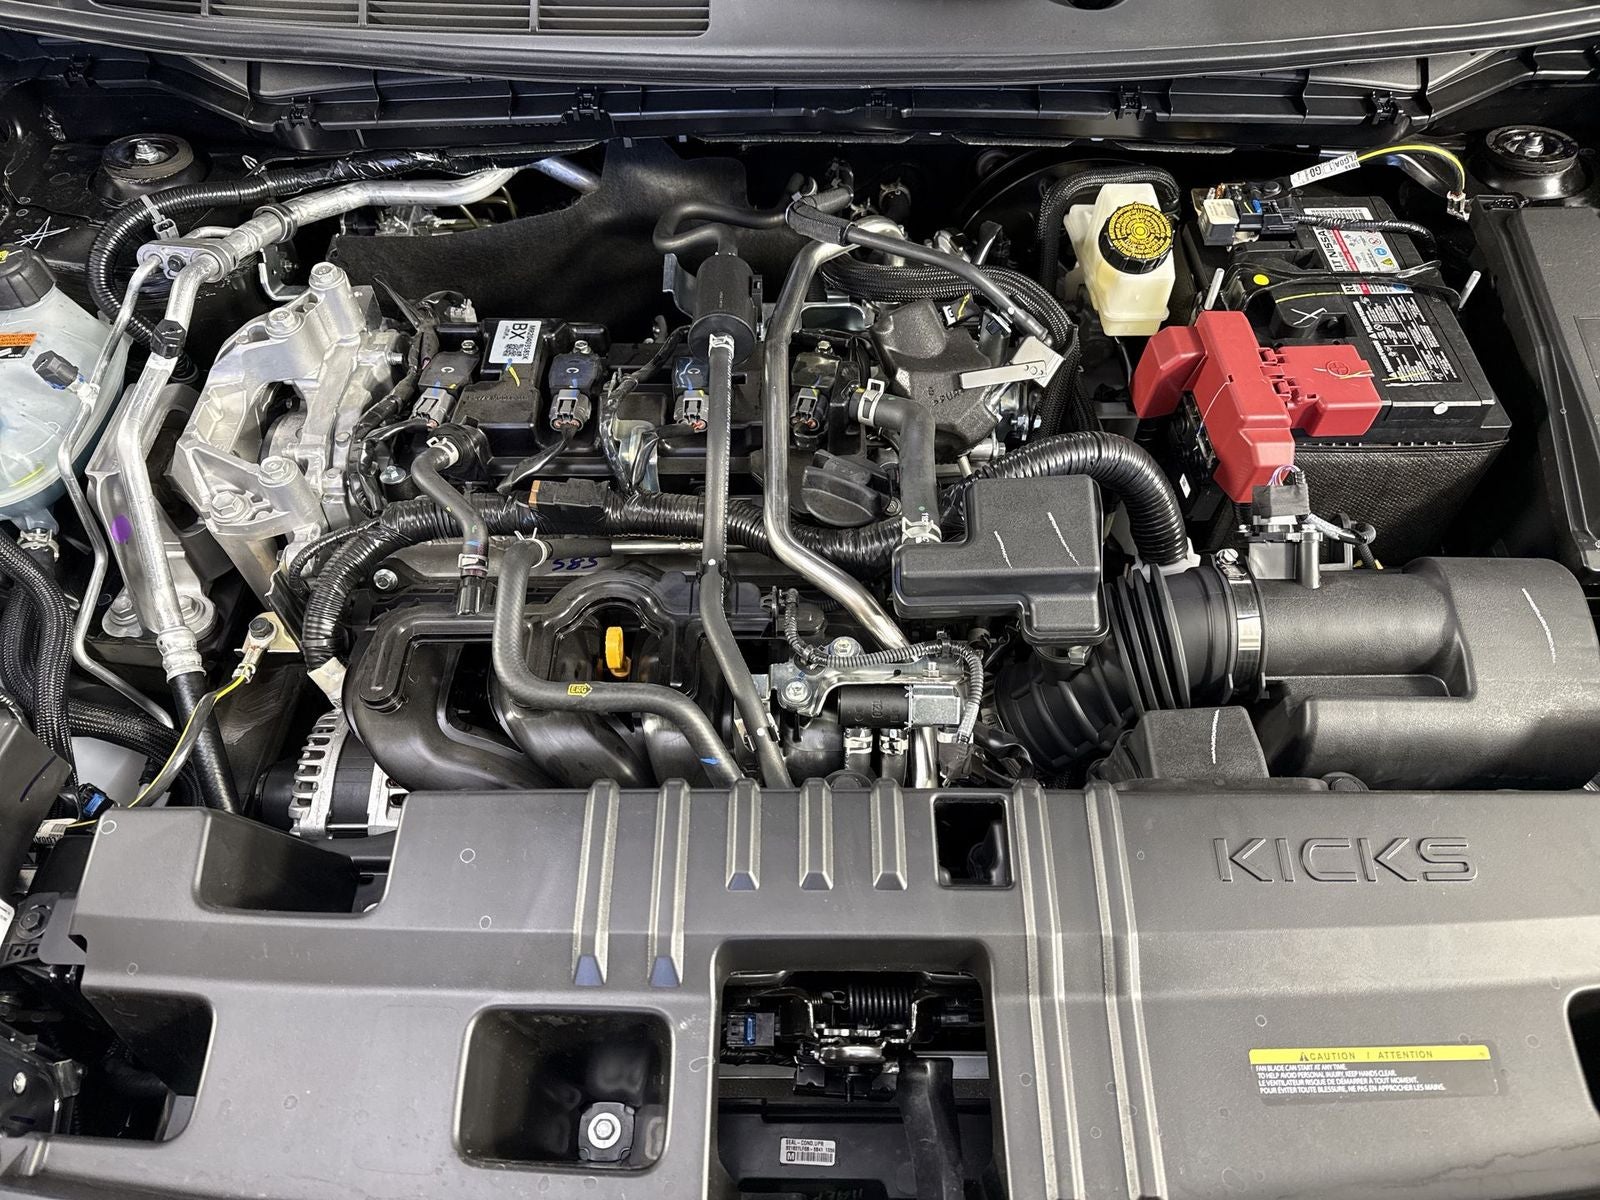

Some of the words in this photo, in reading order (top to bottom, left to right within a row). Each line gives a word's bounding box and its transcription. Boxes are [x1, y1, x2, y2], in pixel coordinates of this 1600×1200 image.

[1316, 227, 1338, 258] NISSA
[509, 324, 528, 339] BX
[1214, 837, 1478, 882] KICKS
[1378, 1050, 1433, 1059] ATTENTION
